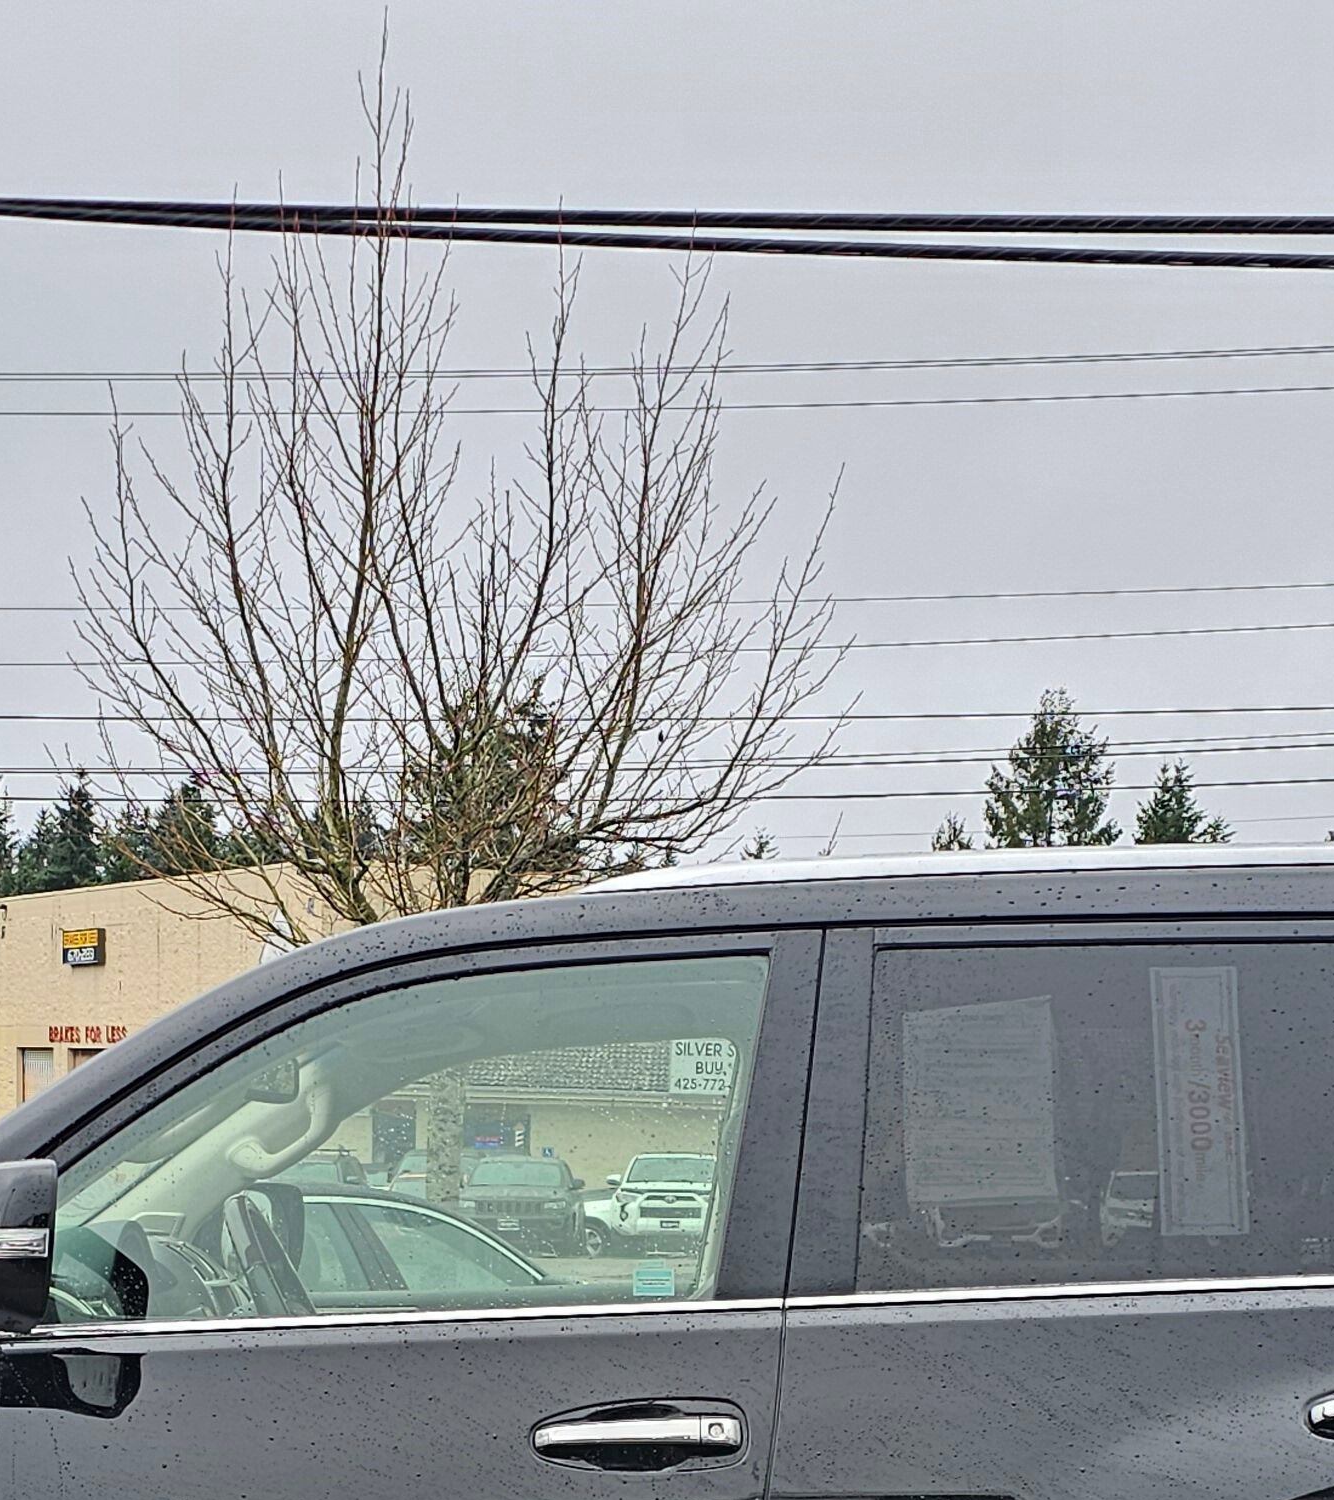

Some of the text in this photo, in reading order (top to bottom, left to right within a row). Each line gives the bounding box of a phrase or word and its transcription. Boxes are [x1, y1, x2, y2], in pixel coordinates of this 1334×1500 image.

[49, 1025, 81, 1043] BRAKES
[85, 1025, 102, 1043] FOR
[675, 1041, 722, 1057] SILVER
